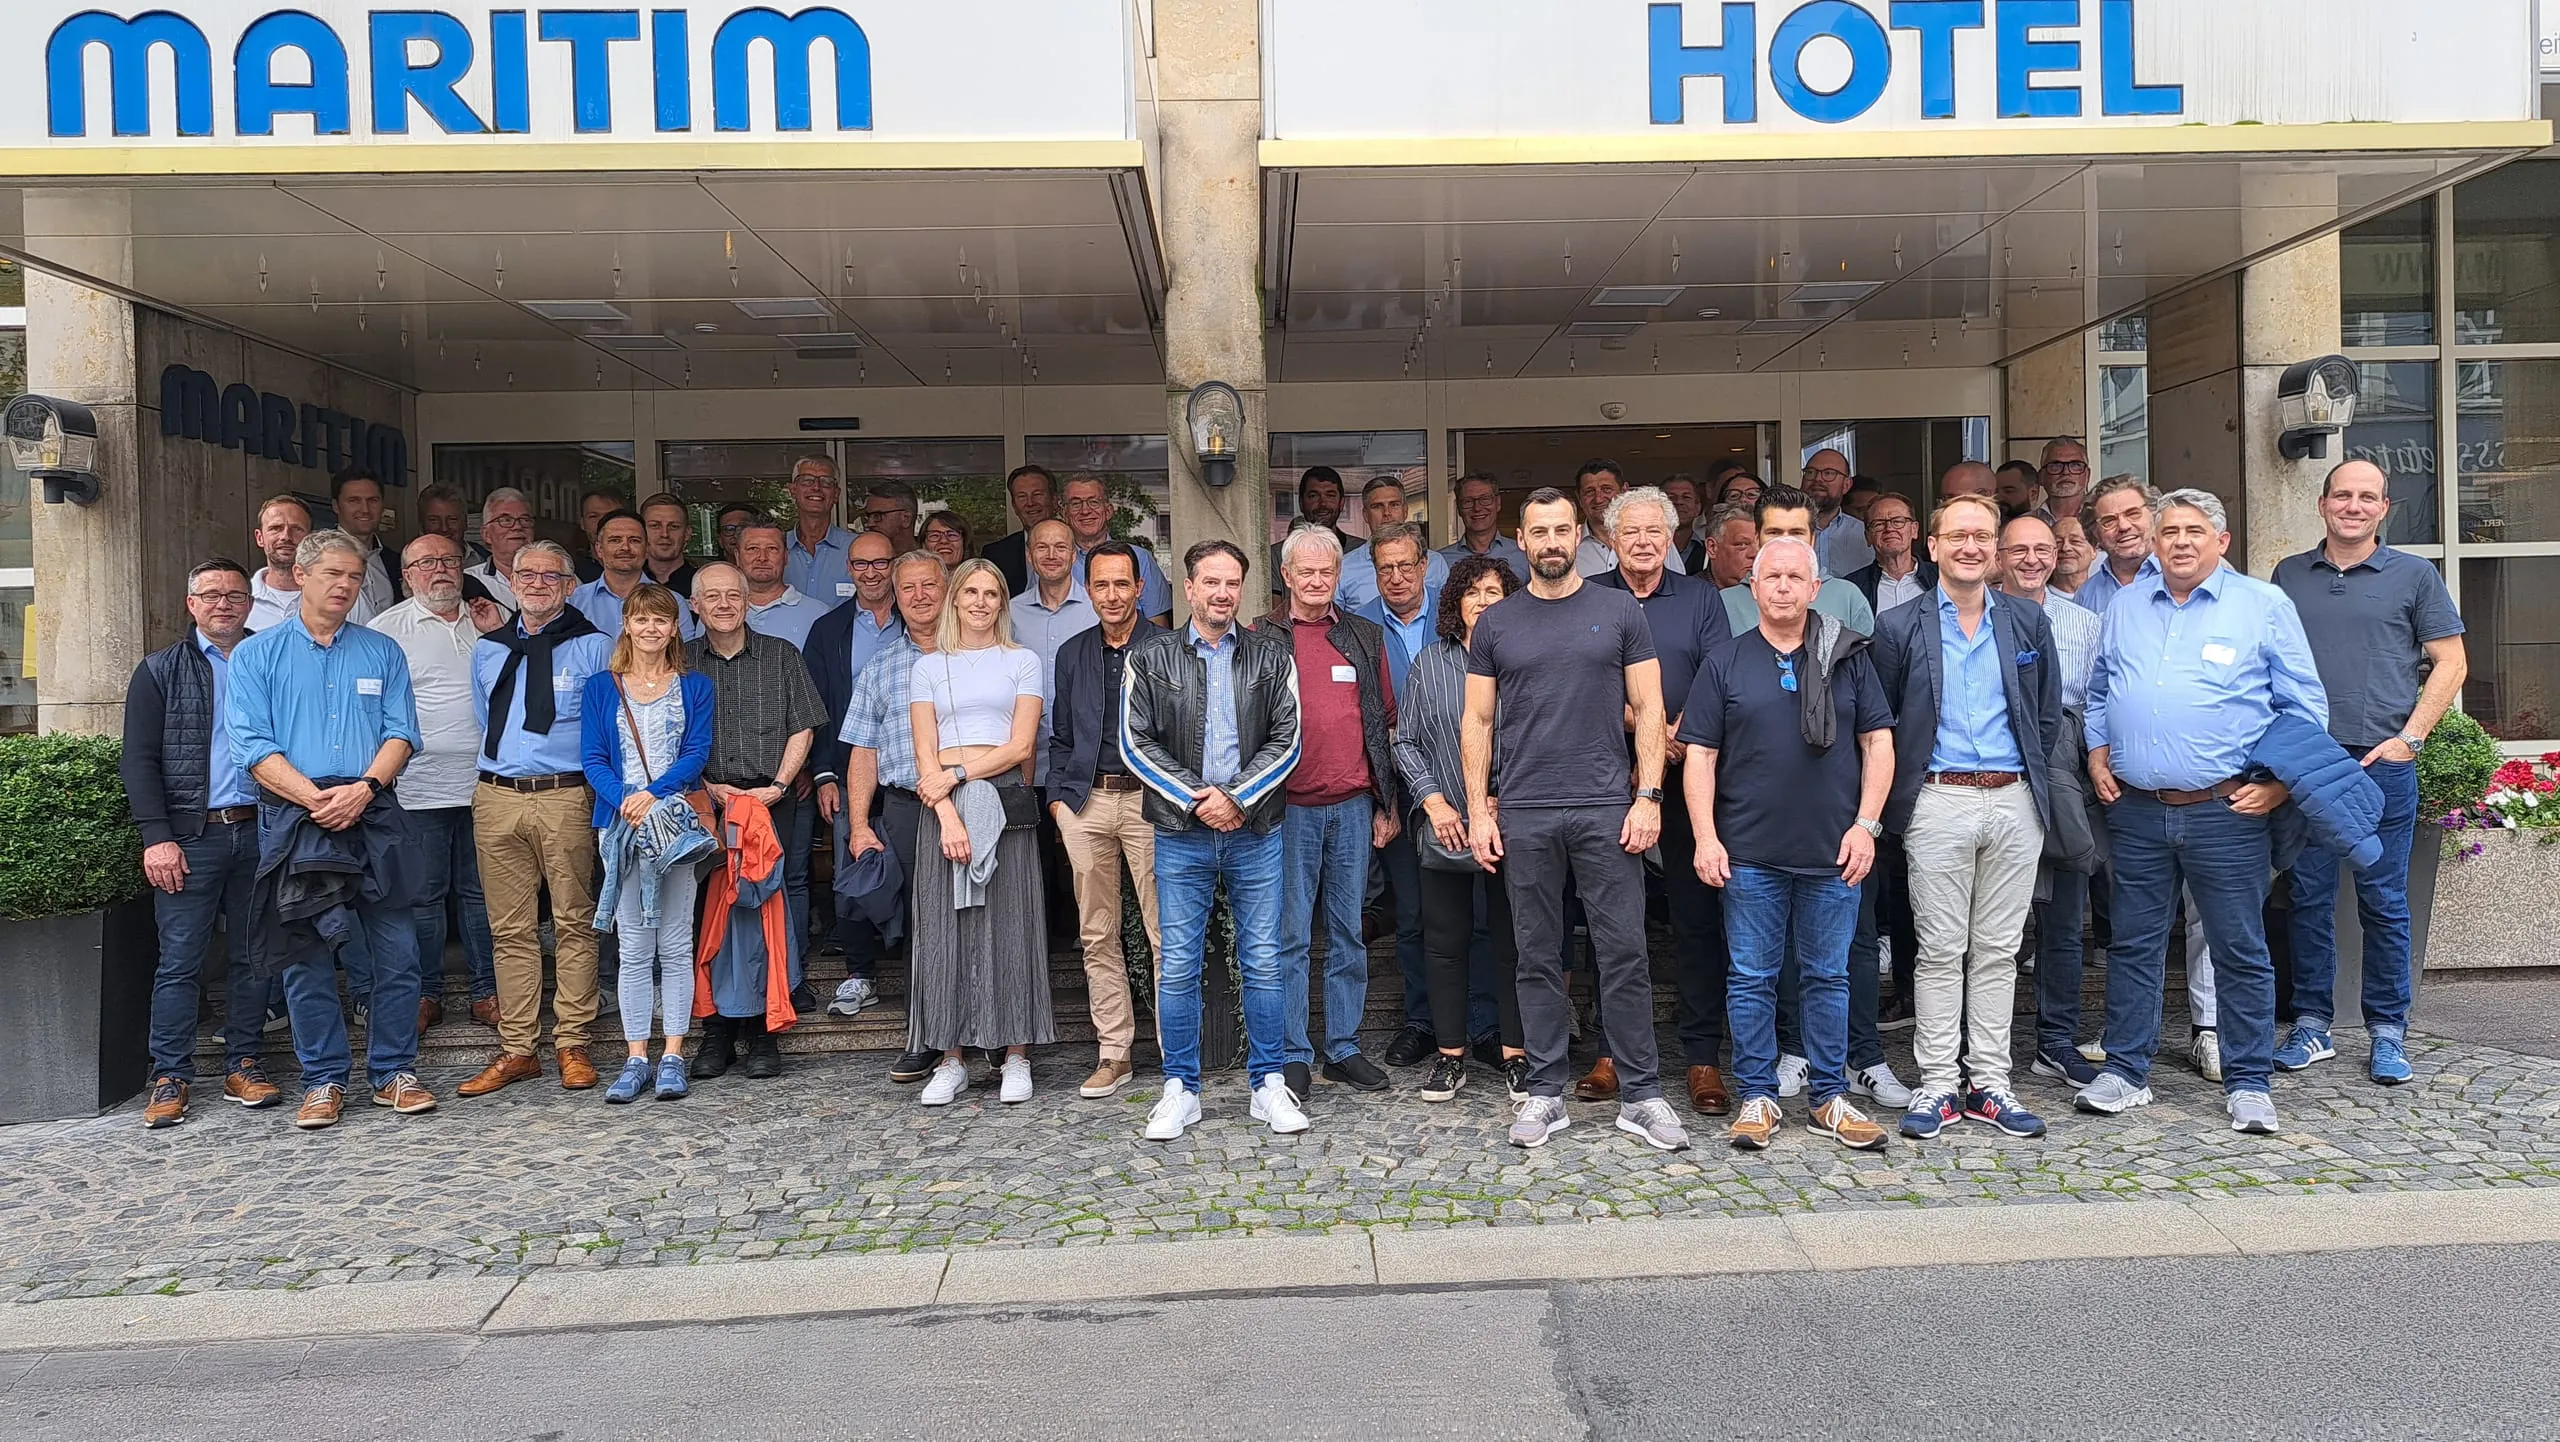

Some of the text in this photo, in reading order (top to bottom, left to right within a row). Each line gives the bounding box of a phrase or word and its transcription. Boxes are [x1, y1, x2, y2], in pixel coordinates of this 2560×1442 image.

[46, 0, 2184, 137] MARITIM HOTEL
[2540, 32, 2560, 55] ei
[161, 364, 408, 487] MARITIM
[1982, 1098, 2001, 1120] N
